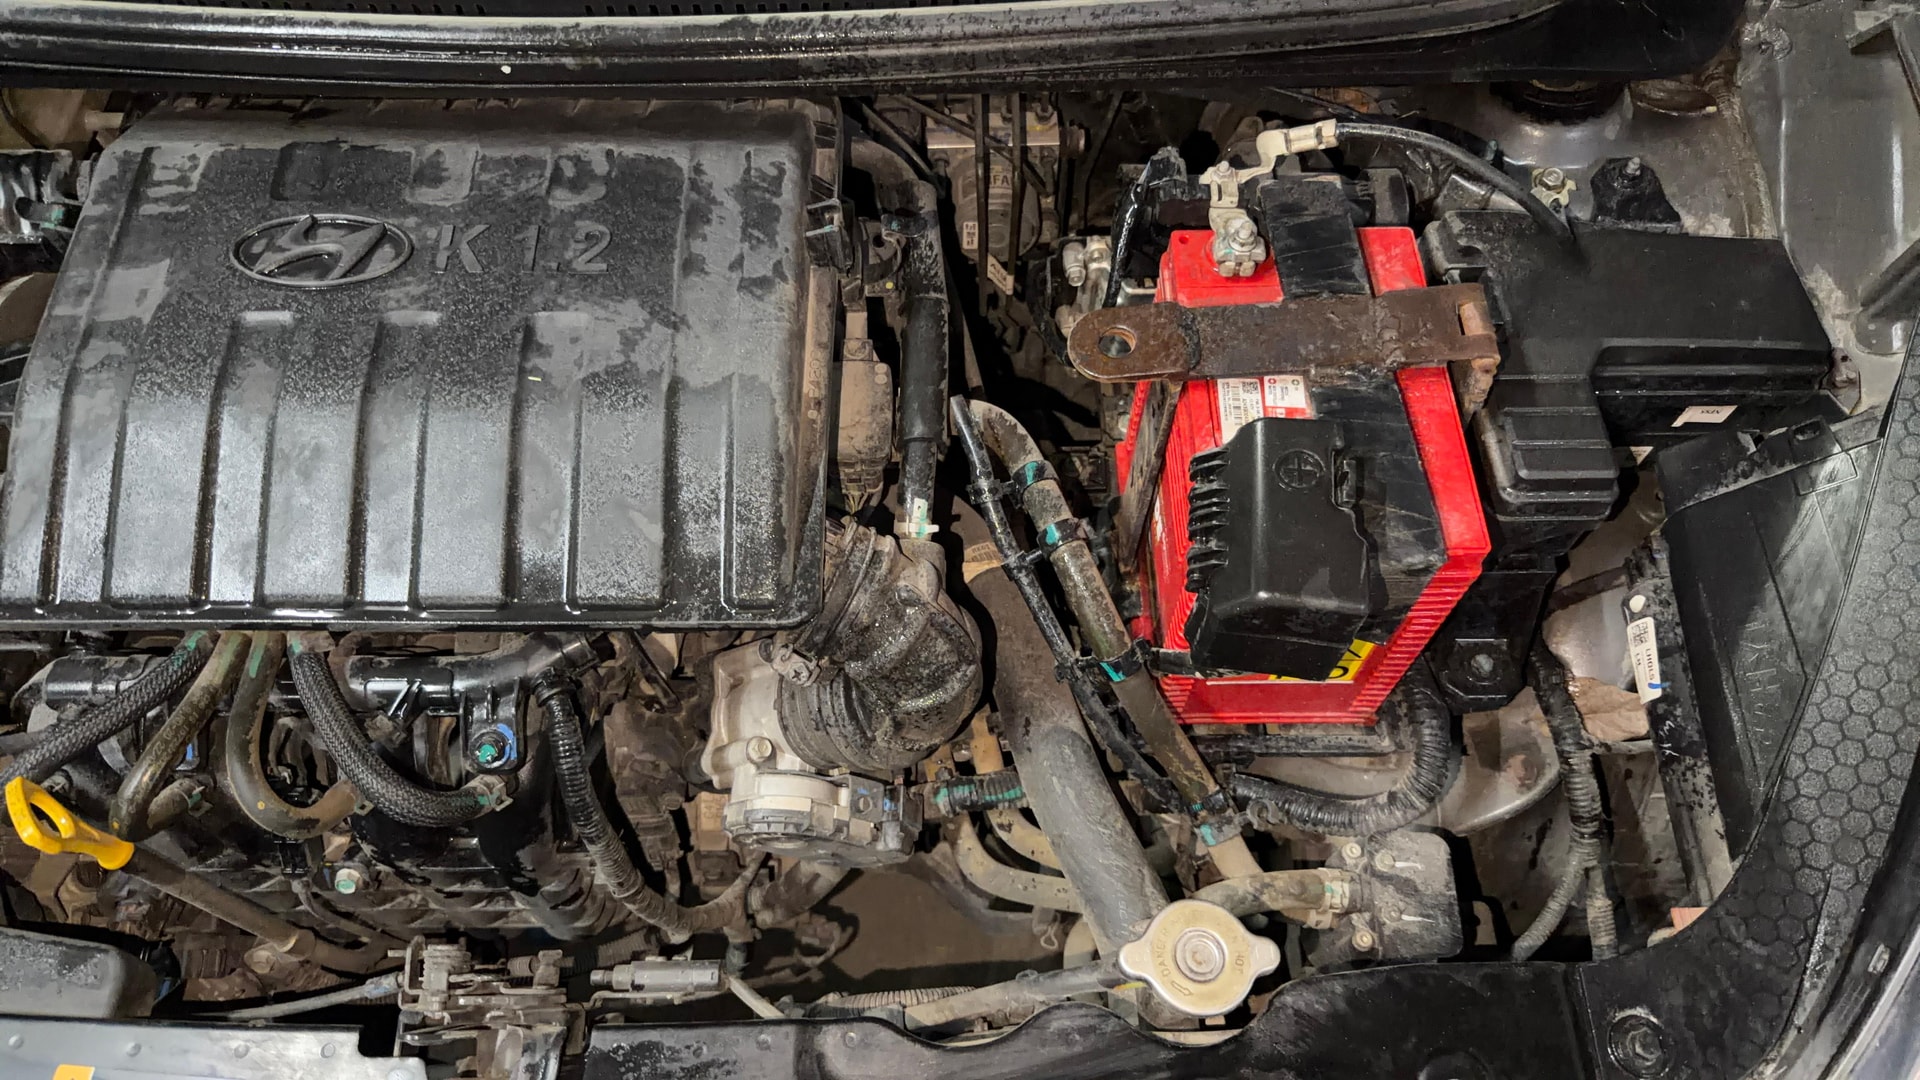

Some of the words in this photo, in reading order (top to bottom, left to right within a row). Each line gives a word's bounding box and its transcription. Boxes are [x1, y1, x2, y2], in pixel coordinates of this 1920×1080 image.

[435, 224, 491, 274] K
[514, 220, 613, 275] 1.2
[1234, 951, 1247, 975] HOT
